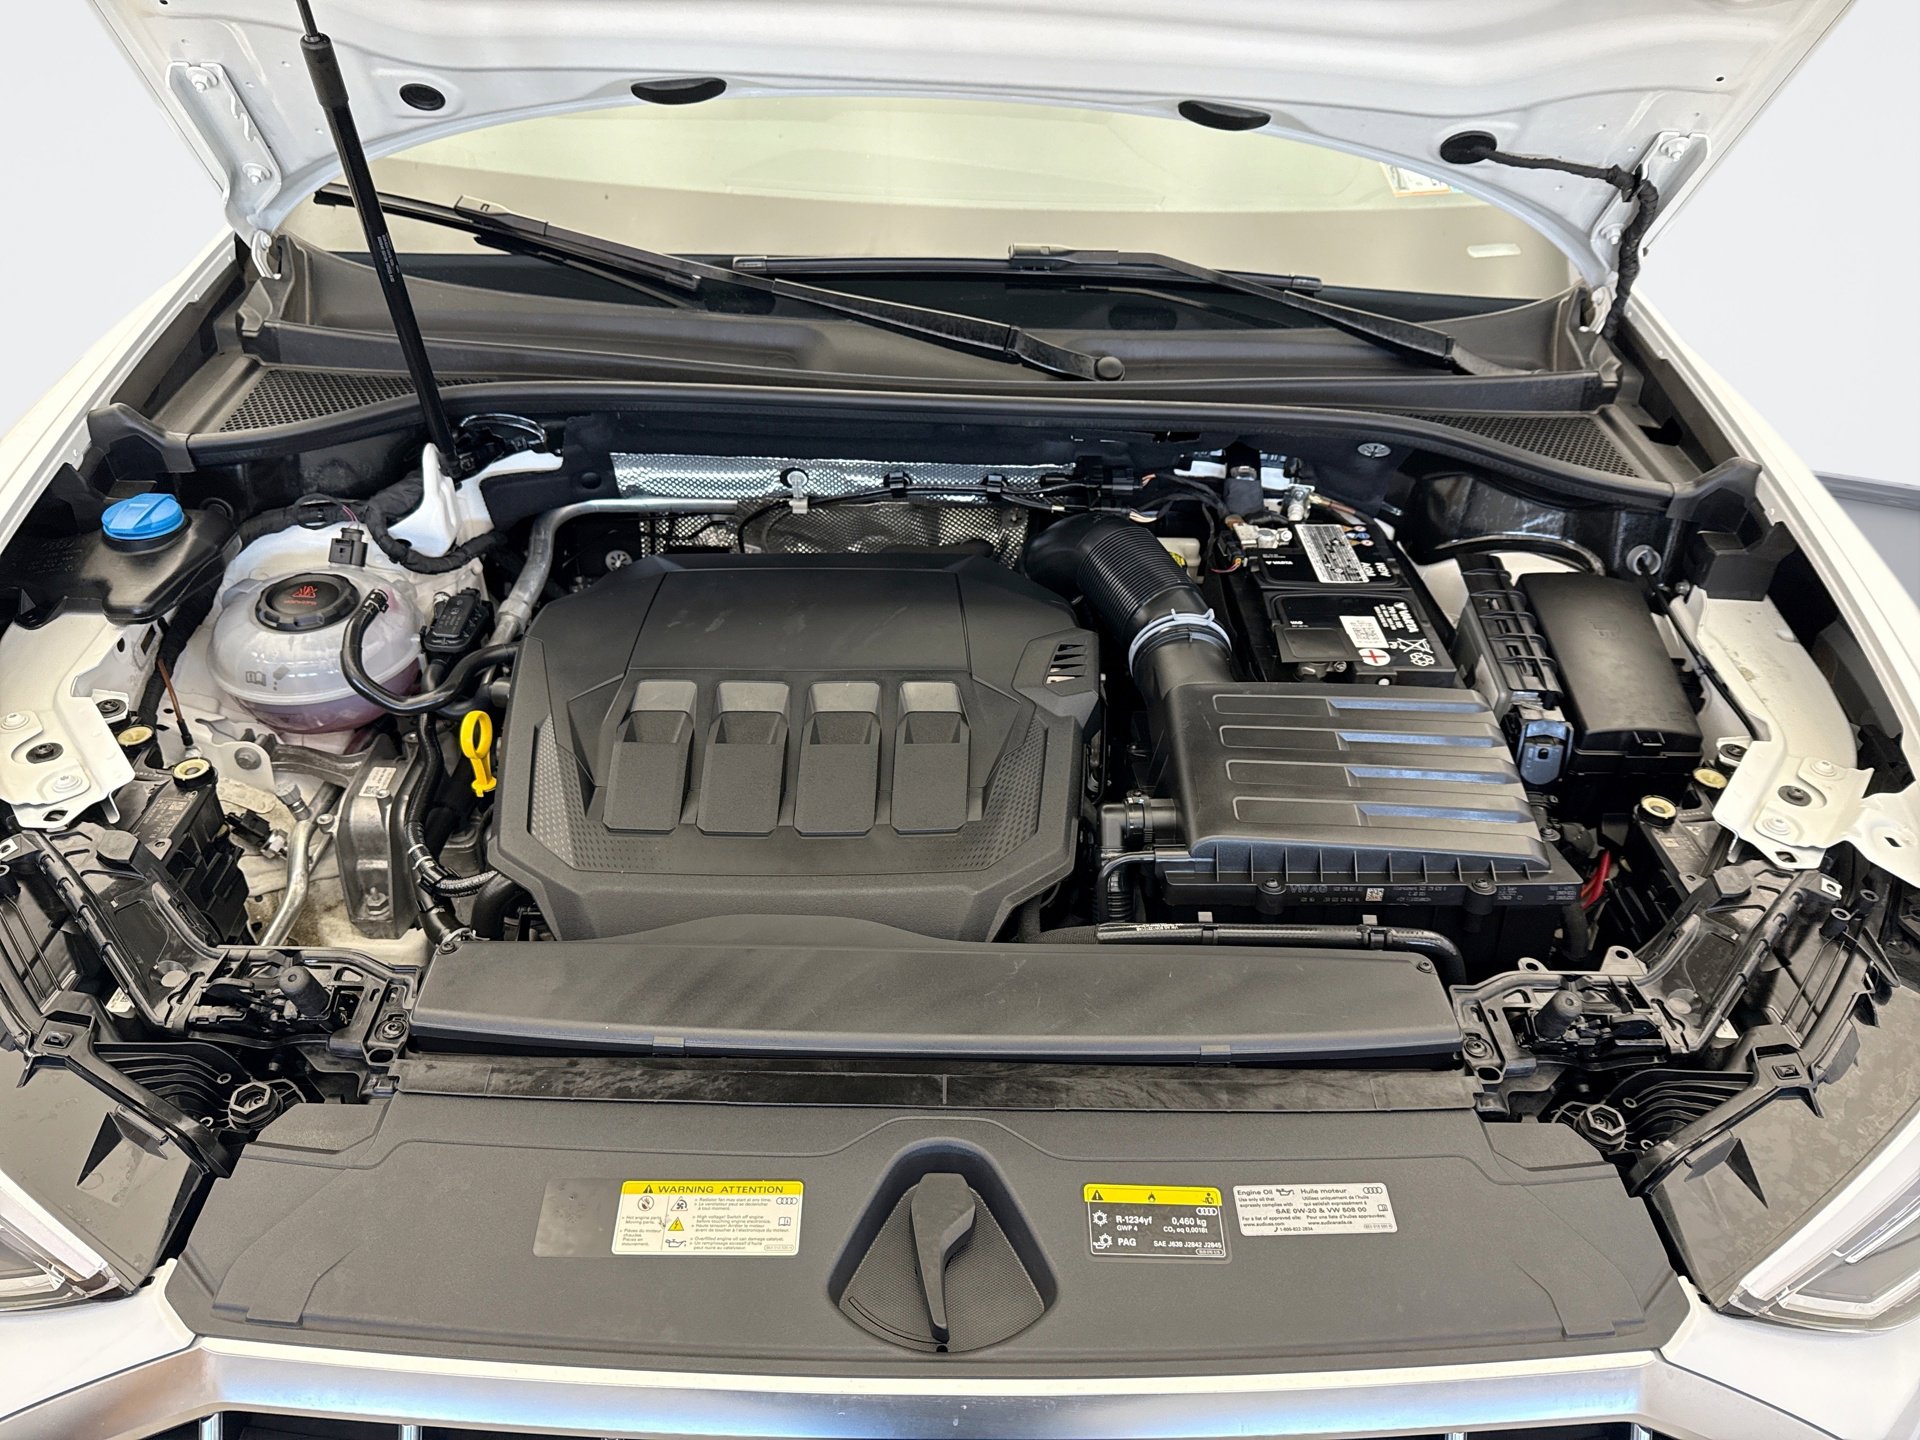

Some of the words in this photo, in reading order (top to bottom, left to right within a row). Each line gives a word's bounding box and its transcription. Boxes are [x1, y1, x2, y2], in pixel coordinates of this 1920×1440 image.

[1398, 610, 1420, 633] VARTA
[1289, 884, 1308, 893] VW
[1311, 885, 1328, 893] AG
[720, 1186, 784, 1194] ATTENTION
[1115, 1216, 1152, 1225] R-1234yf
[1196, 1218, 1207, 1227] kg
[1117, 1238, 1136, 1247] PAG
